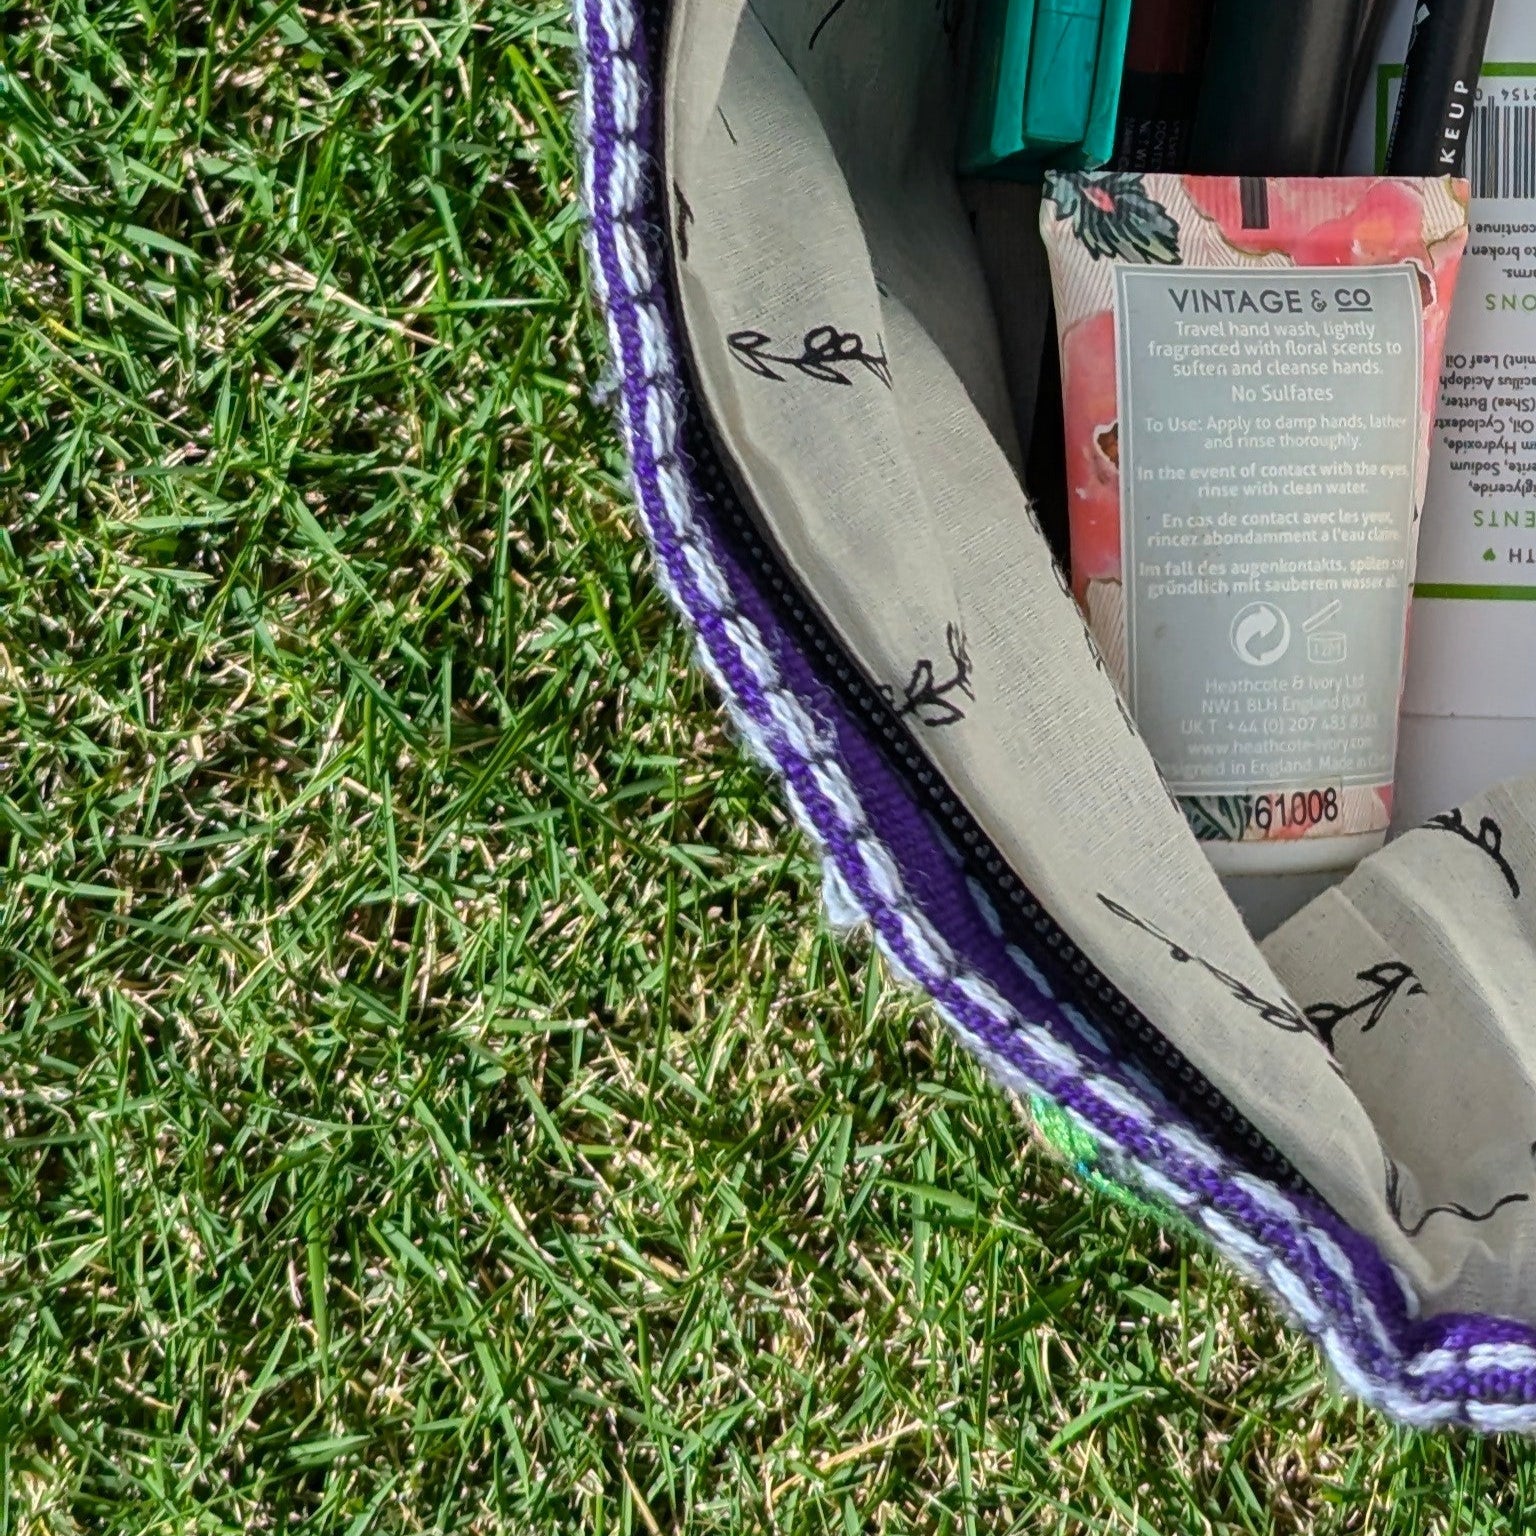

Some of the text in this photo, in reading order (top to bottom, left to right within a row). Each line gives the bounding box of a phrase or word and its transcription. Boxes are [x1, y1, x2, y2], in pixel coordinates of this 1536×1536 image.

[1472, 246, 1520, 259] broken
[1169, 288, 1371, 313] VINTAGE & CO
[1175, 320, 1375, 340] Travel hand wash, lightly
[1148, 340, 1401, 361] fragranced with floral scents to
[1232, 360, 1261, 375] and
[1267, 360, 1328, 375] cleanse
[1333, 359, 1384, 375] hands.
[1470, 355, 1499, 369] Leaf
[1232, 384, 1333, 402] No Sulfates
[1441, 394, 1487, 411] Butter,
[1492, 396, 1536, 412] (Shea)
[1145, 418, 1163, 432] To
[1168, 417, 1202, 431] Use:
[1206, 416, 1250, 434] Apply
[1255, 418, 1271, 430] to
[1276, 416, 1315, 433] damp
[1321, 414, 1367, 430] hands,
[1509, 417, 1534, 433] Oil,
[1204, 434, 1362, 451] and rinse thoroughly.
[1443, 436, 1516, 454] Hydroxide,
[1138, 467, 1153, 480] In
[1159, 466, 1186, 479] the
[1190, 465, 1235, 479] event
[1240, 463, 1257, 477] of
[1260, 464, 1316, 477] contact
[1319, 462, 1352, 476] with
[1356, 462, 1377, 475] the
[1450, 462, 1500, 475] Sodium
[1198, 481, 1368, 498] rinse with clean water.
[1162, 513, 1182, 528] En
[1187, 515, 1213, 528] cas
[1217, 512, 1237, 527] de
[1241, 511, 1299, 525] contact
[1302, 511, 1335, 524] avec
[1339, 510, 1358, 523] les
[1148, 531, 1198, 546] rincez
[1203, 530, 1317, 545] abondamment
[1333, 528, 1364, 542] l'eau
[1140, 562, 1161, 576] Im
[1165, 561, 1193, 576] fall
[1197, 560, 1225, 576] des
[1233, 578, 1260, 592] mit
[1265, 576, 1337, 592] sauberem
[1291, 676, 1303, 689] &
[1202, 698, 1240, 714] NW1
[1254, 787, 1338, 830] 61008
